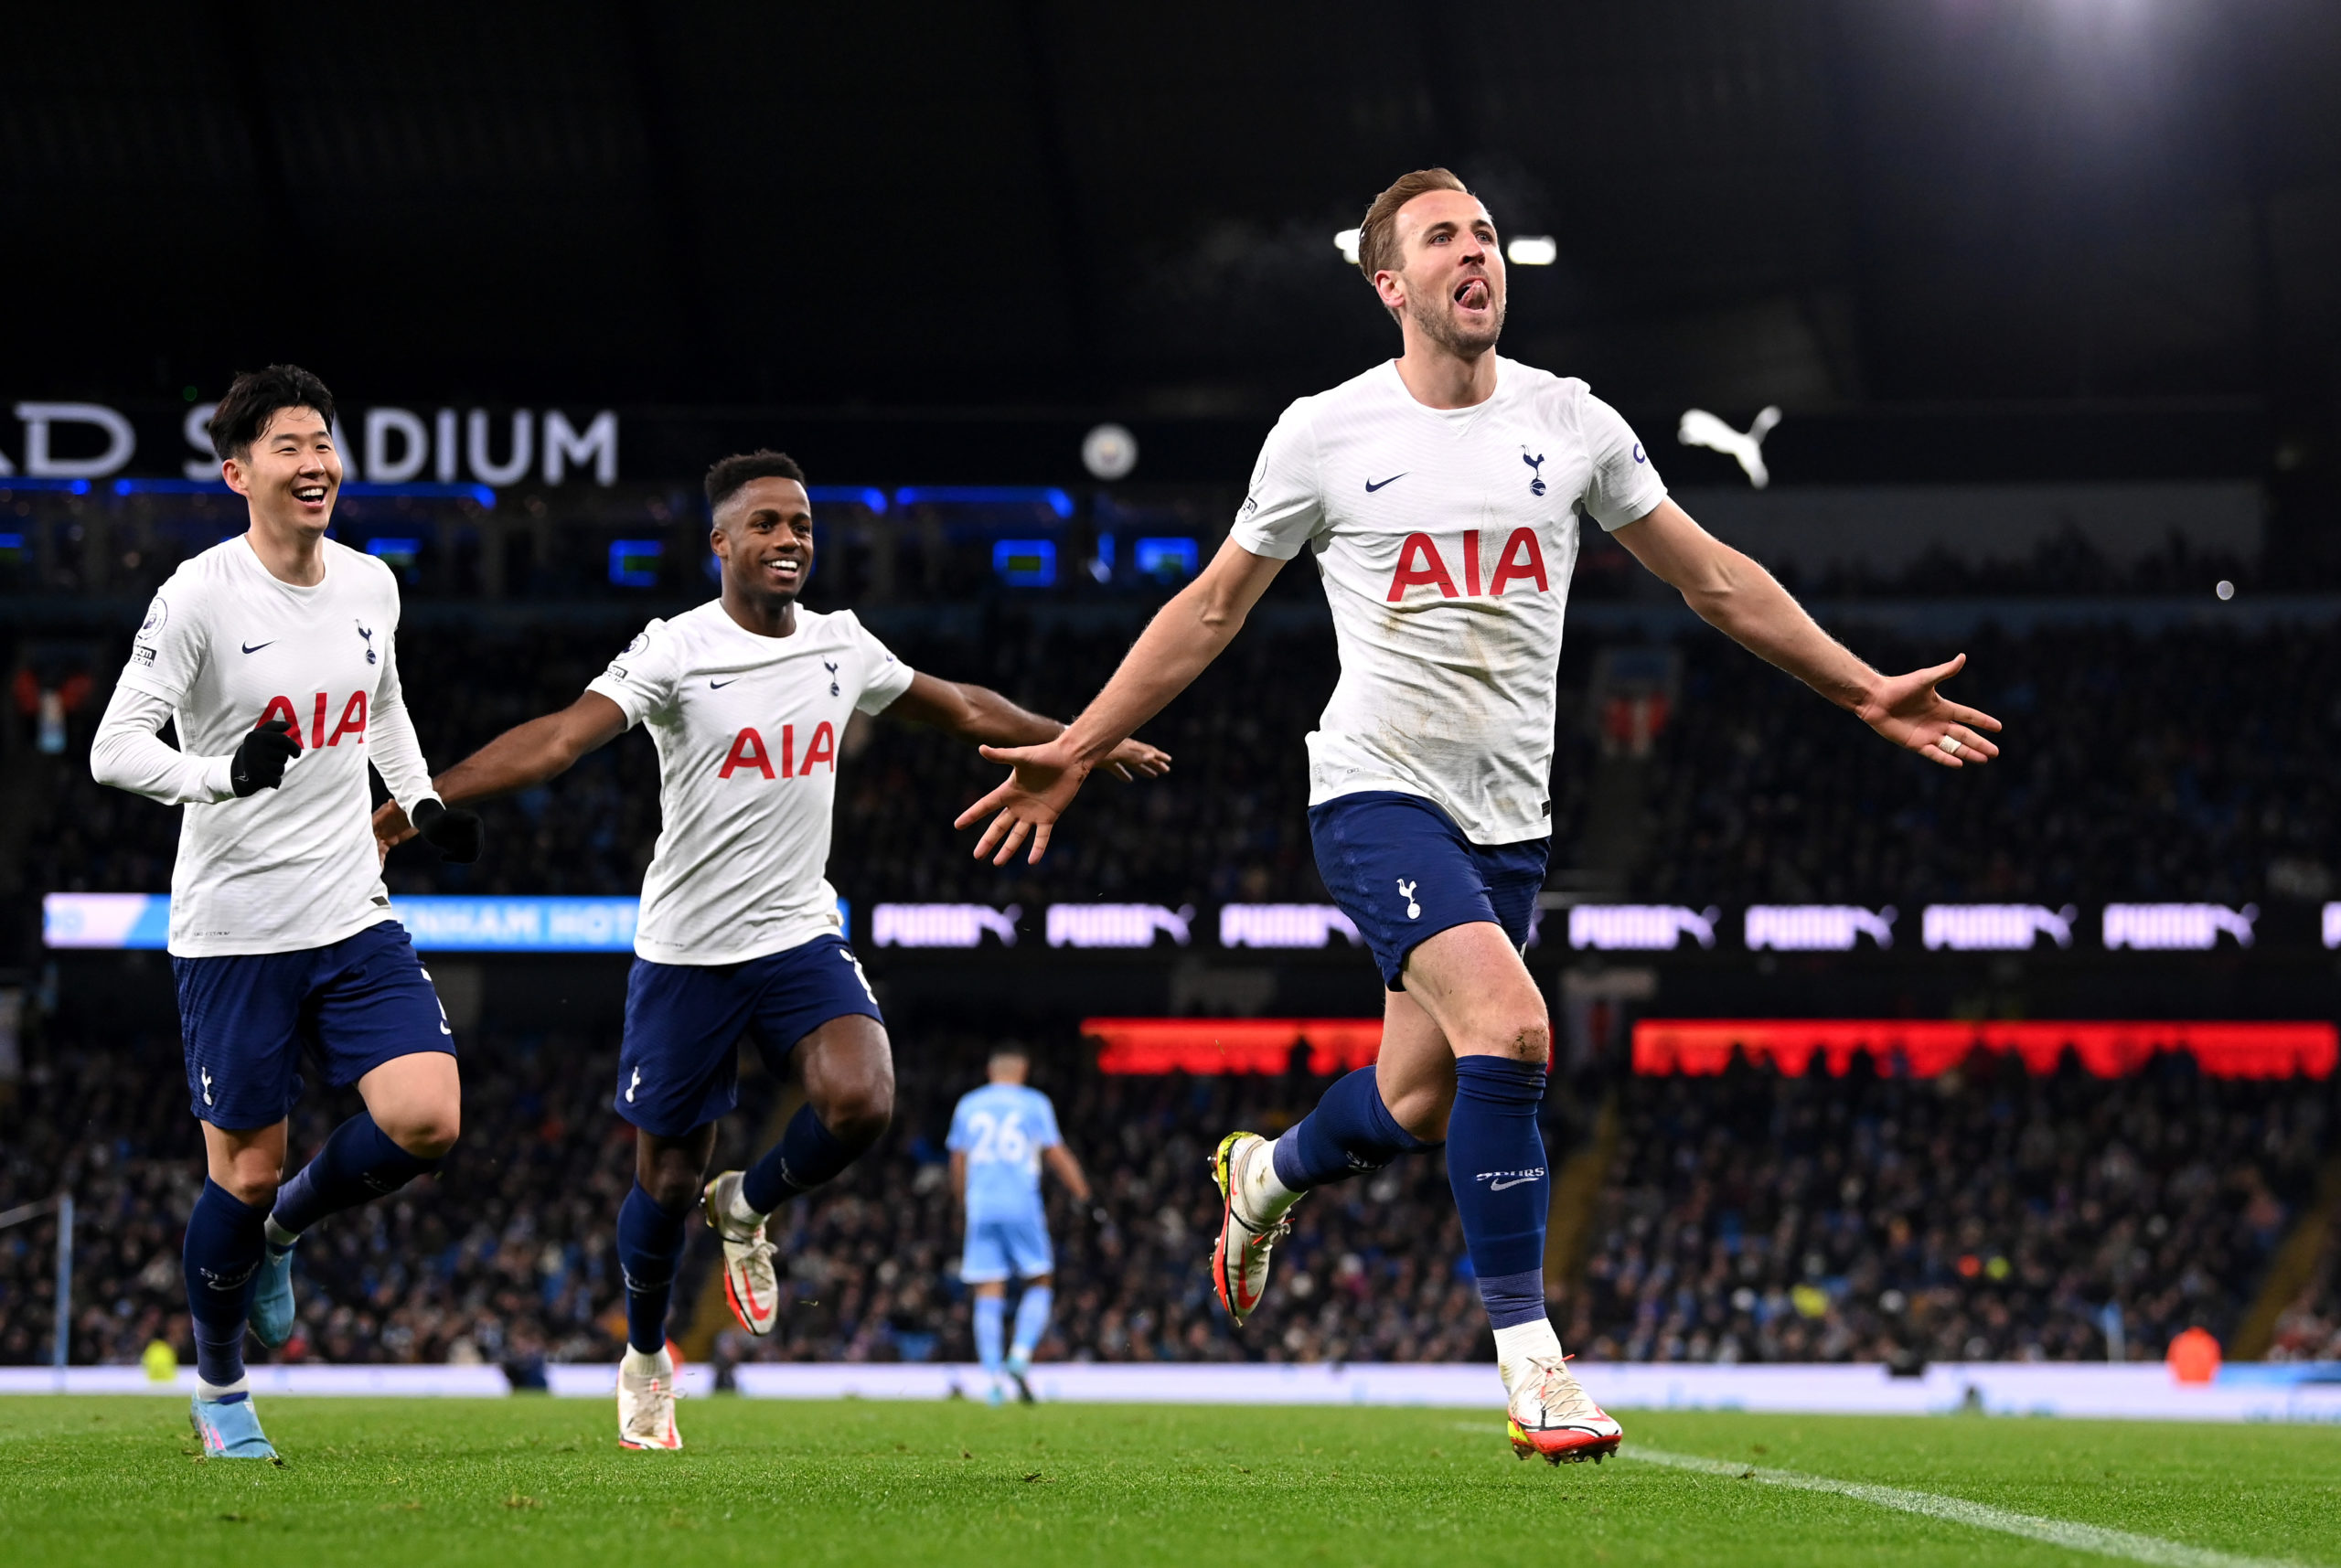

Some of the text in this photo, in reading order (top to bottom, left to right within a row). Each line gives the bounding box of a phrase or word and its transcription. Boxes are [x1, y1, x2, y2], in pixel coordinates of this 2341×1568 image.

[0, 401, 619, 486] D SDIUM
[1386, 527, 1550, 603] AIA
[255, 689, 368, 750] AIA
[718, 720, 834, 780] AIA
[967, 1111, 1027, 1164] 26
